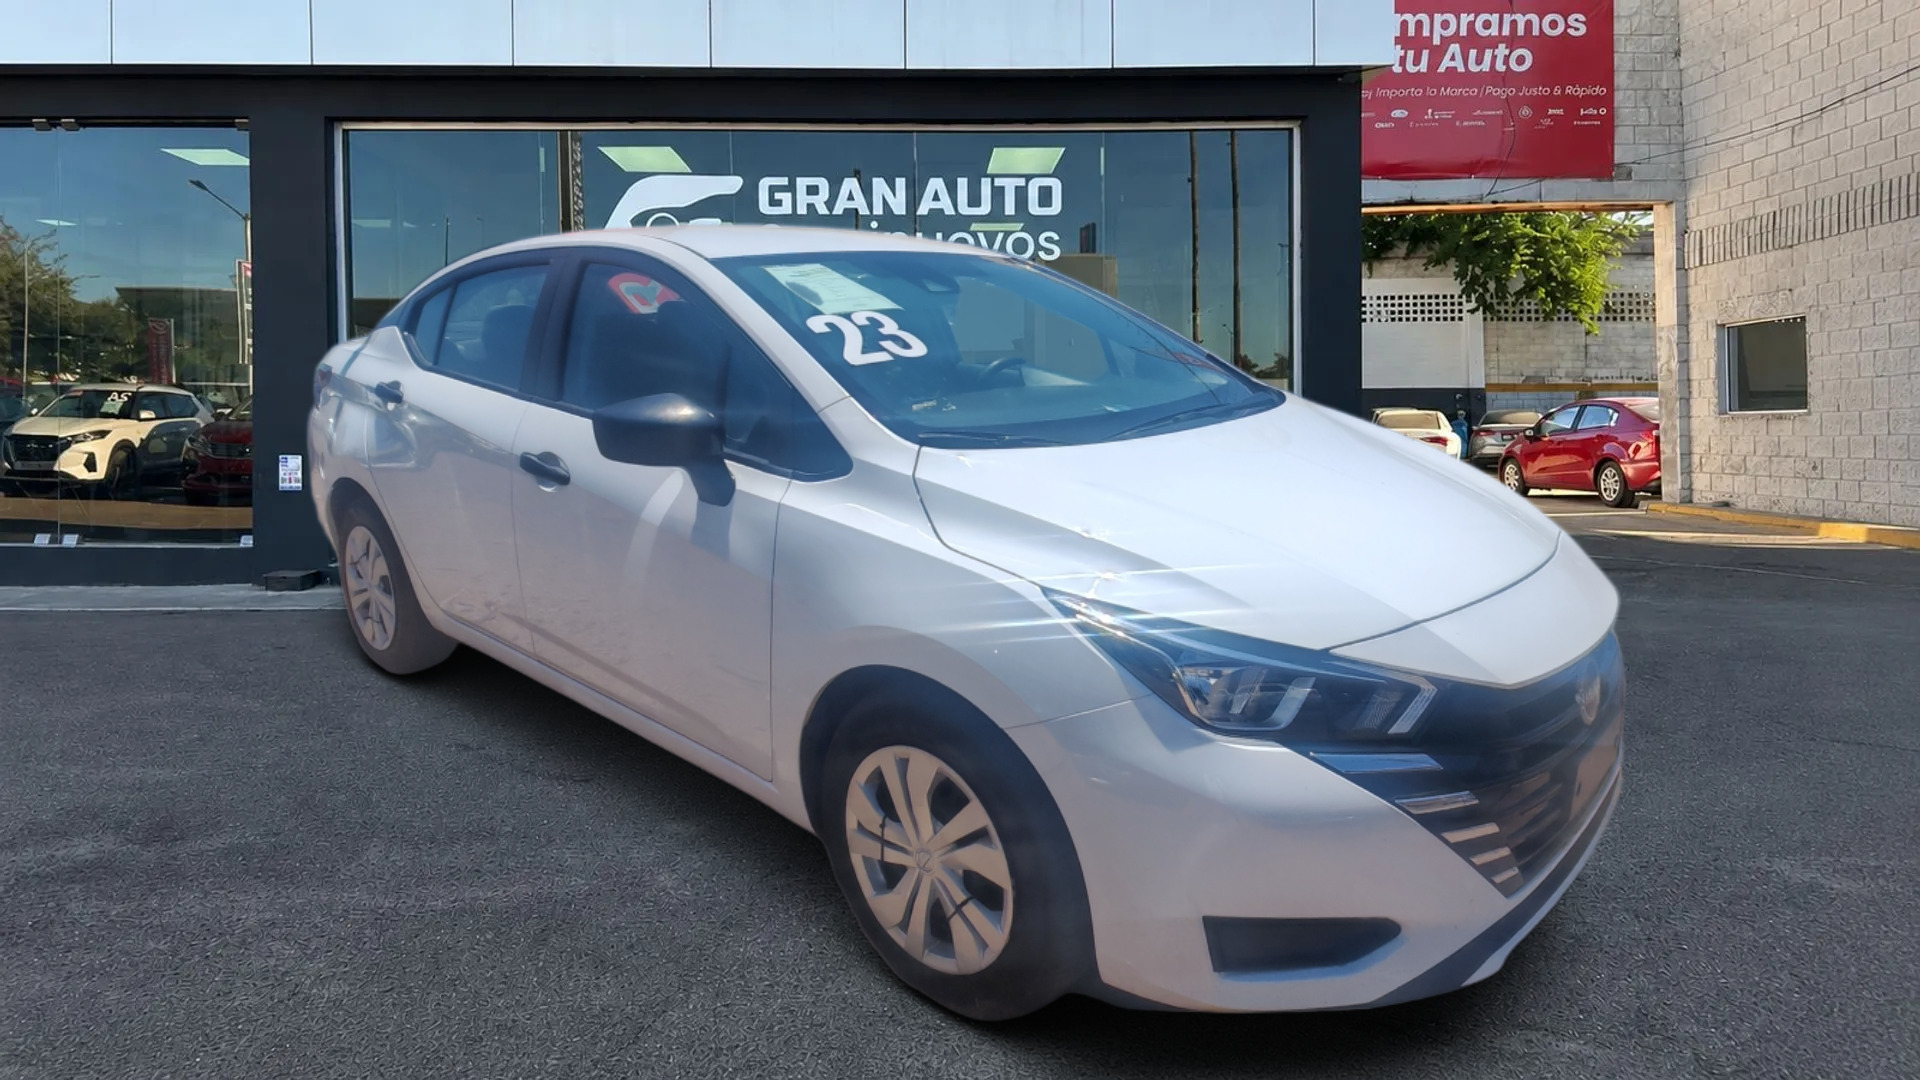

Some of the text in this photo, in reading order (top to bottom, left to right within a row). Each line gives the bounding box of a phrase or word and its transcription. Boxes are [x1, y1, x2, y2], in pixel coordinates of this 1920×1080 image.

[1394, 12, 1587, 45] mpramos
[1392, 43, 1533, 73] tu Auto
[1376, 87, 1423, 100] Importa
[1426, 86, 1437, 97] la
[1440, 86, 1478, 96] Marca
[1518, 85, 1550, 96] Justo
[1553, 85, 1561, 96] &
[758, 176, 1063, 216] GRAN AUTO
[805, 310, 929, 366] 23
